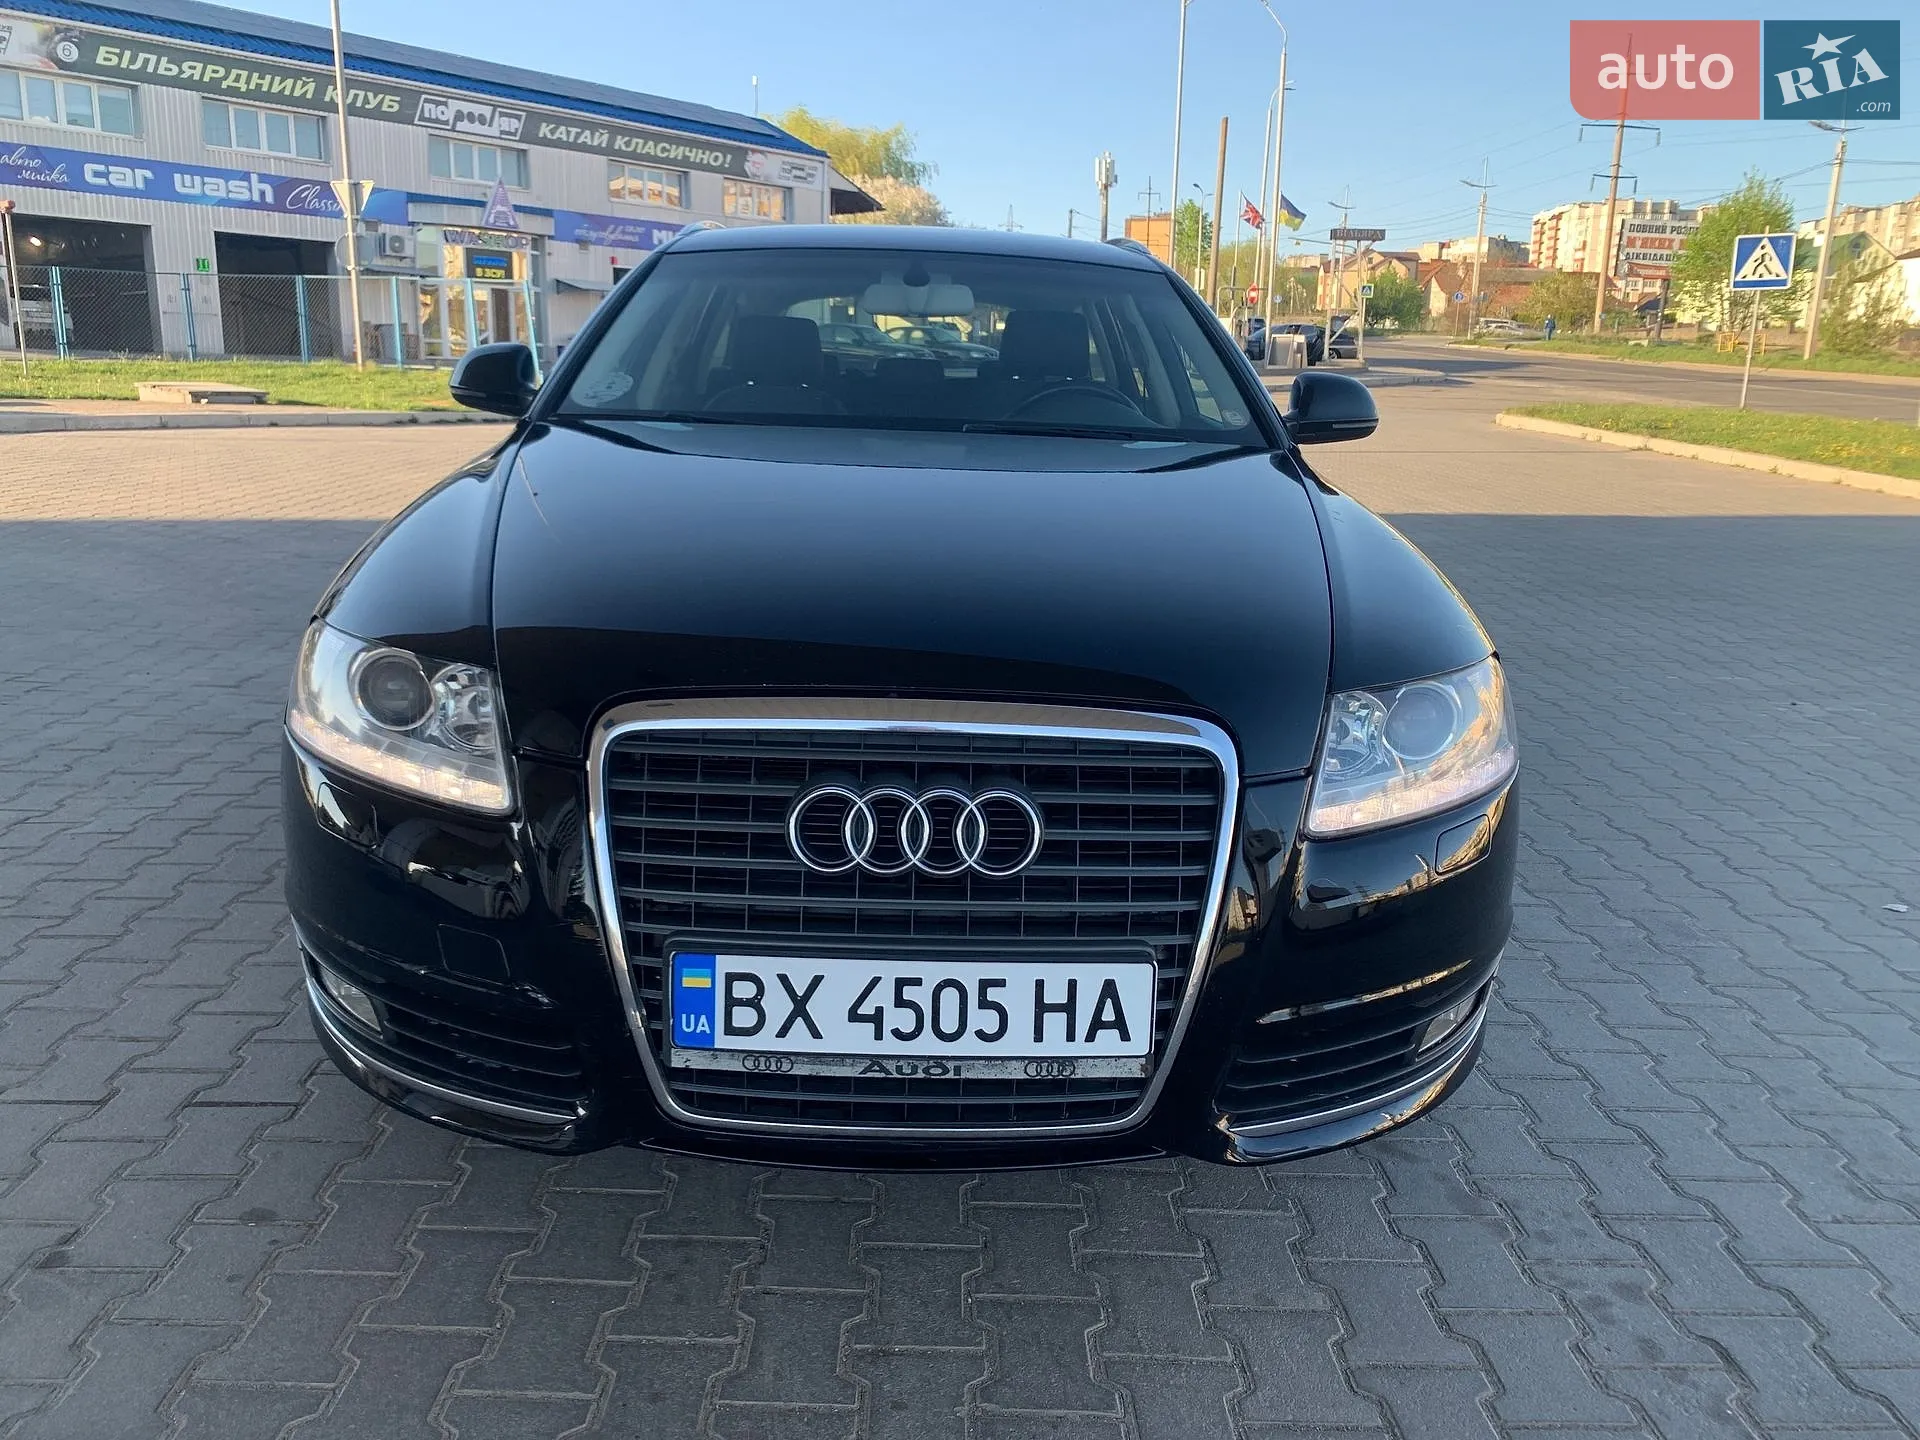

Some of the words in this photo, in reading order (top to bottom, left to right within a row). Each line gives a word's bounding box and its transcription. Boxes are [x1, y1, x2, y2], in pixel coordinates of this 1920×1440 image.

[62, 43, 73, 58] 6
[95, 45, 317, 99] БІЛЬЯРДНИЙ
[323, 85, 401, 113] КЛУБ
[0, 146, 41, 168] авто
[538, 122, 610, 148] КАТАЙ
[613, 135, 733, 168] КЛАСИЧНО!
[17, 163, 70, 183] мийка
[83, 163, 154, 191] car
[173, 171, 275, 204] wash
[286, 184, 342, 213] Classi
[1628, 222, 1668, 235] ПОВНИЙ
[723, 971, 825, 1040] BX
[847, 976, 1009, 1042] 4505
[1033, 978, 1132, 1043] HA
[681, 1013, 711, 1034] UA
